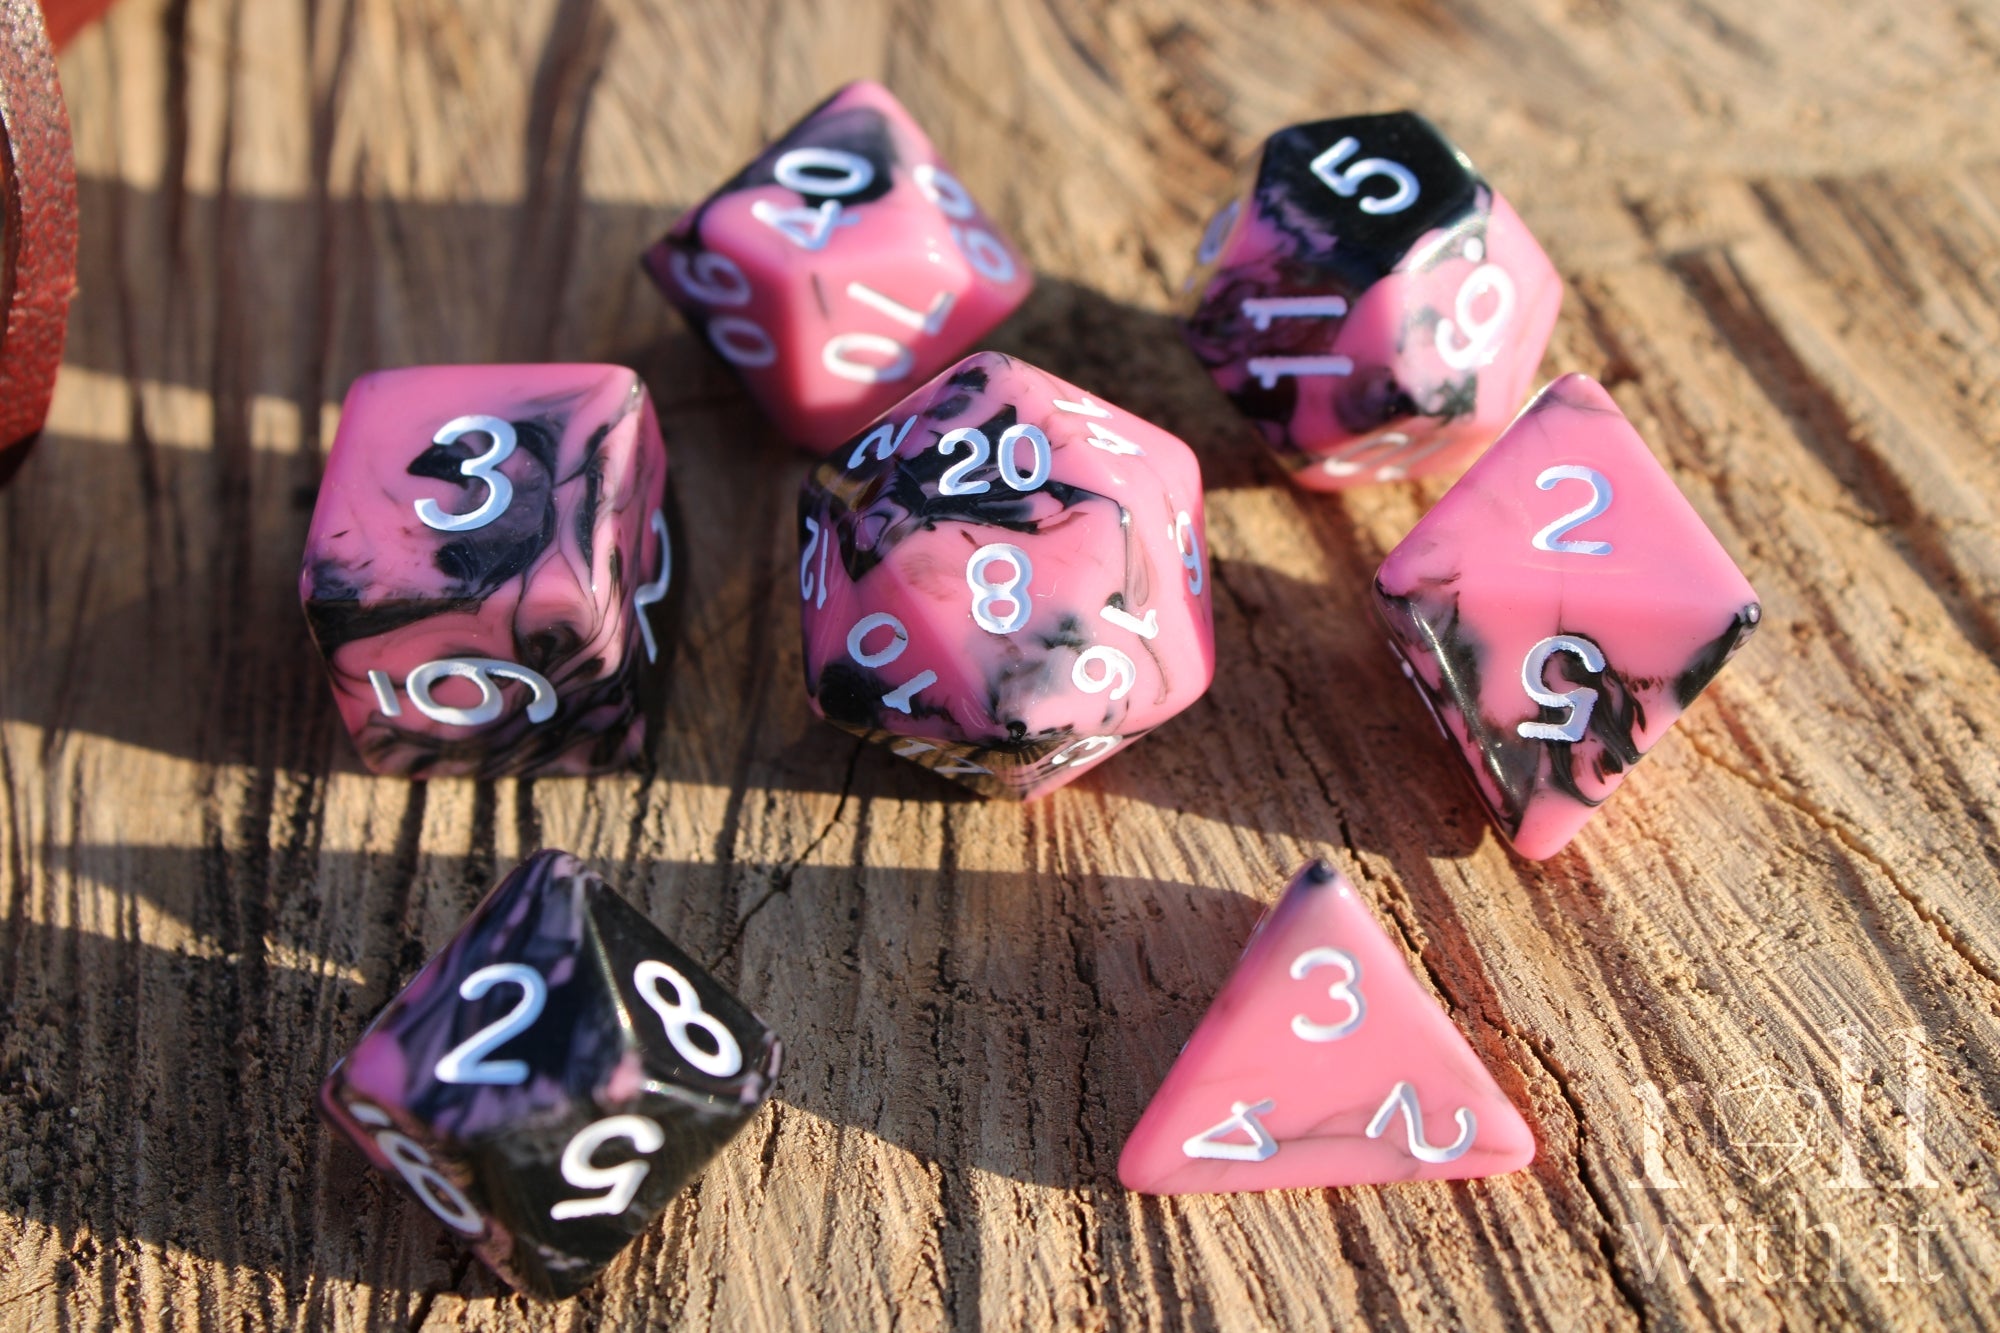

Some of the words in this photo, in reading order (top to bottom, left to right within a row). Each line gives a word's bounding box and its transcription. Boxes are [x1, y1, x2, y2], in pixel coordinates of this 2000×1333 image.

[752, 146, 874, 250] 40
[1310, 136, 1420, 215] 5
[1242, 295, 1354, 389] 11
[413, 414, 518, 532] 3
[847, 415, 918, 469] 2
[938, 423, 1051, 495] 20
[1532, 465, 1613, 555] 2
[966, 543, 1032, 634] 8
[847, 612, 938, 714] 10
[1072, 604, 1158, 700] 16
[1517, 634, 1606, 741] 5
[434, 962, 547, 1085] 2
[633, 960, 742, 1078] 8
[1290, 946, 1367, 1042] 3
[549, 1114, 665, 1221] 5
[1182, 1099, 1278, 1162] 4
[1365, 1081, 1477, 1163] 2
